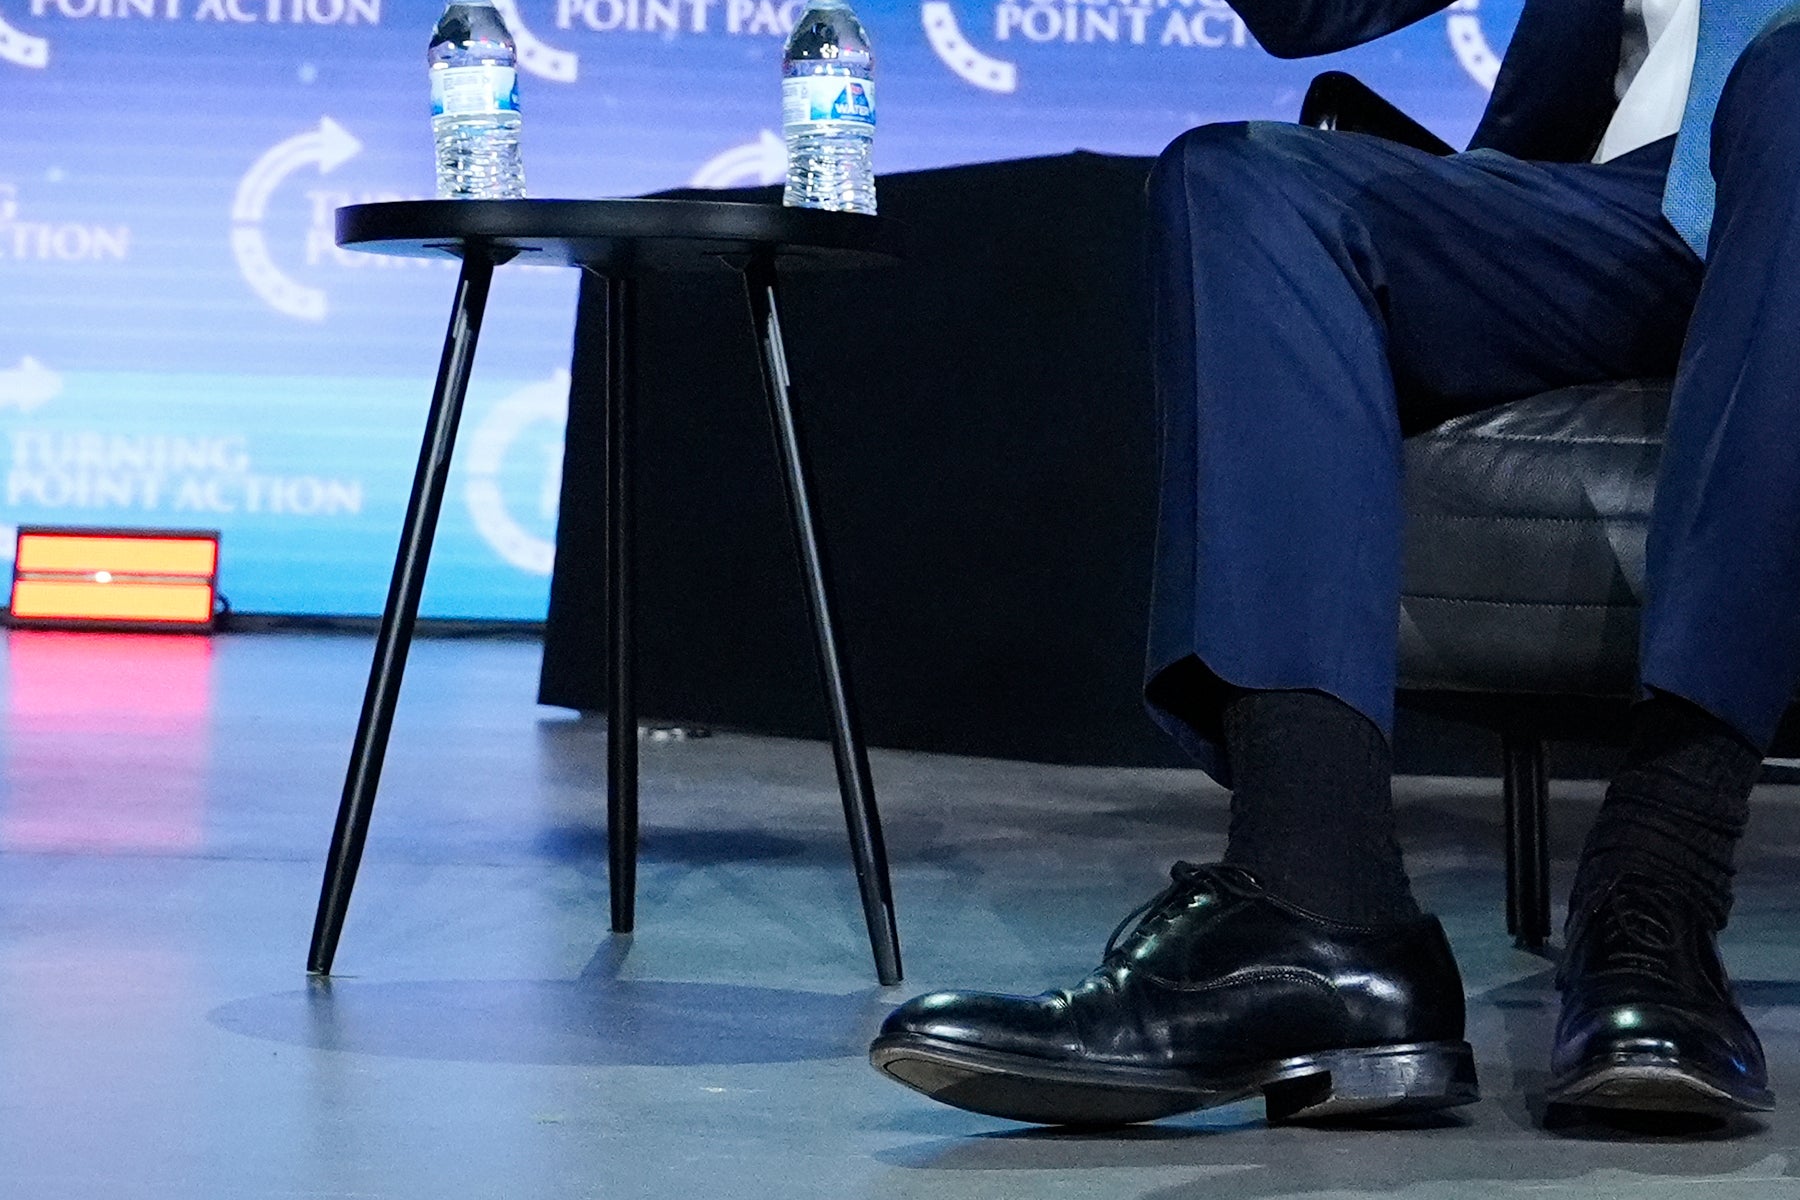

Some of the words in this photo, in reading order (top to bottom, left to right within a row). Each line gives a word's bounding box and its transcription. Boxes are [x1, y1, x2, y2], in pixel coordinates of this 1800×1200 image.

[996, 4, 1151, 44] POINT
[0, 221, 131, 260] TION
[11, 431, 250, 472] TURNING
[7, 466, 162, 509] POINT
[175, 475, 363, 516] ACTION
